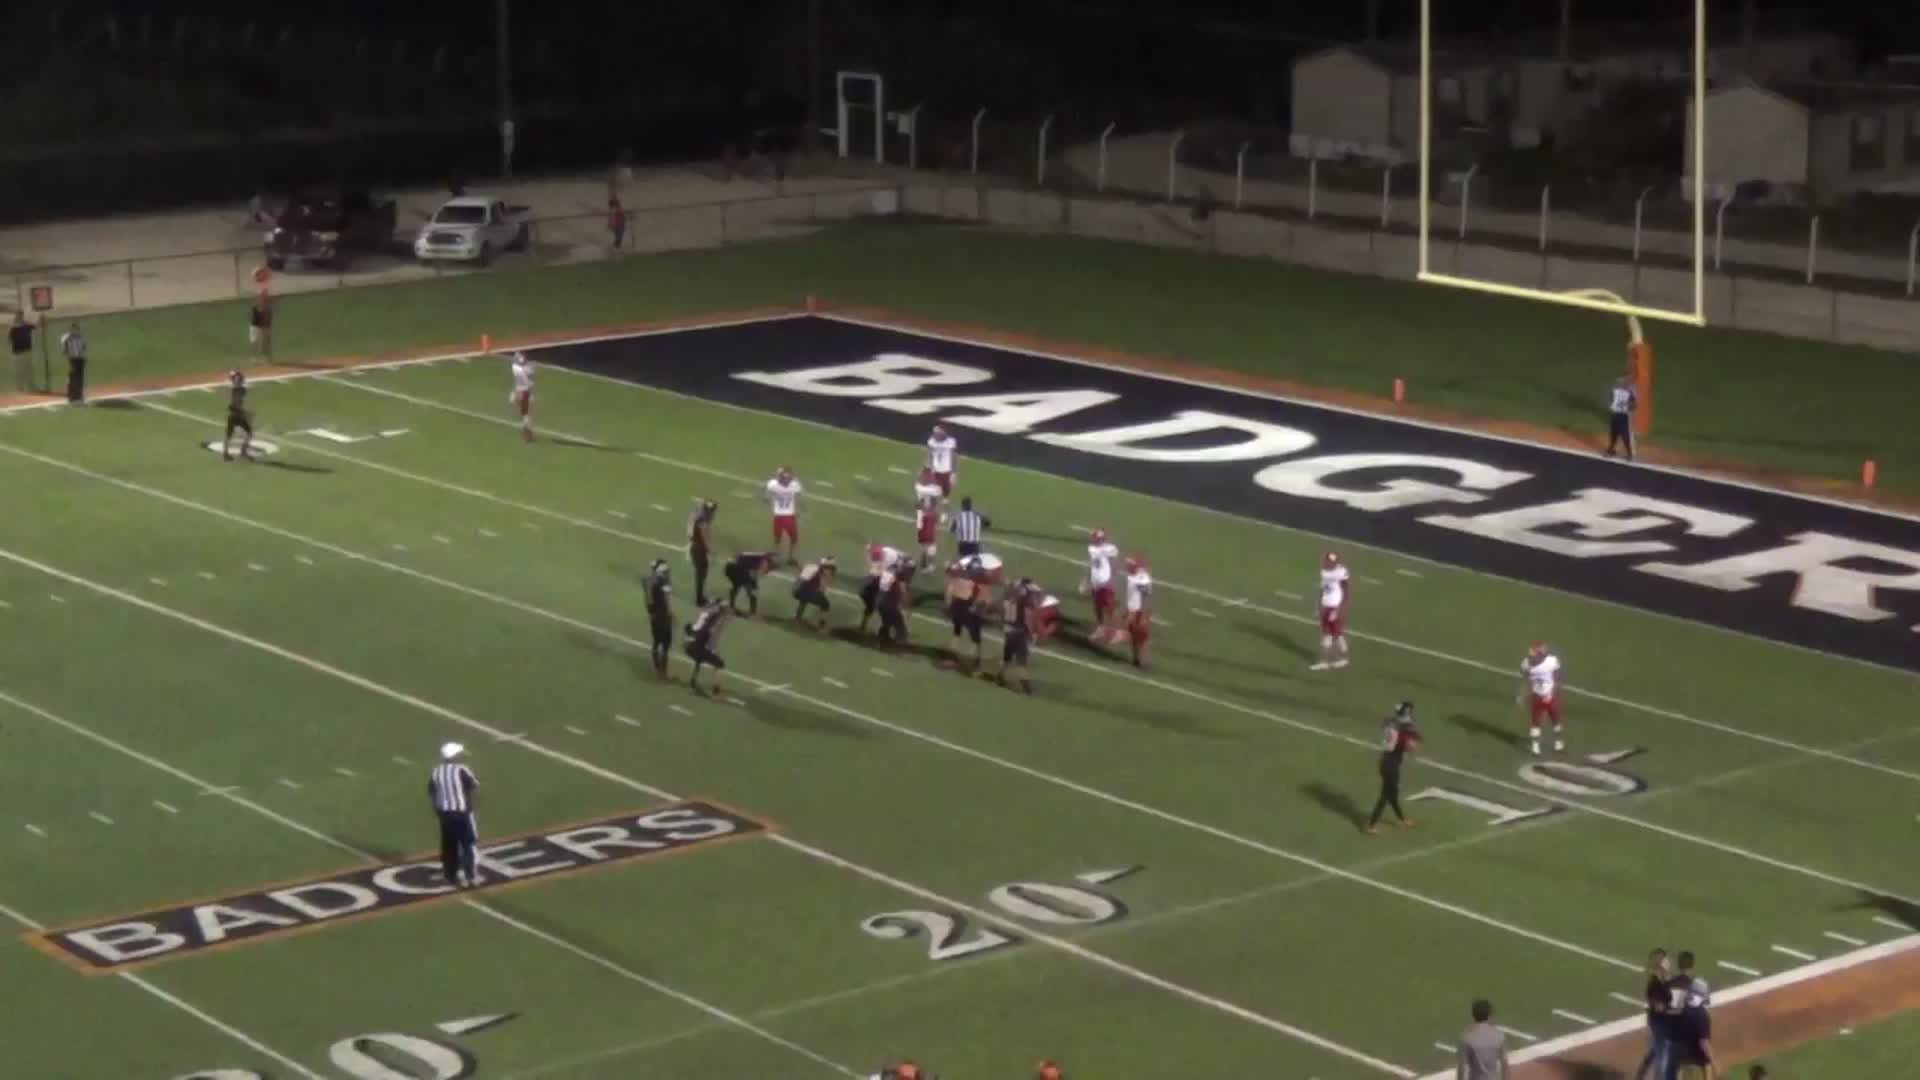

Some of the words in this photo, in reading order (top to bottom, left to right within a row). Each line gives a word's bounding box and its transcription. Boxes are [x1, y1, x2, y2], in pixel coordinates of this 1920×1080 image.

[728, 354, 1920, 635] BADGER
[1403, 761, 1648, 826] 10
[66, 807, 736, 963] BADGERS
[860, 882, 1128, 961] 20
